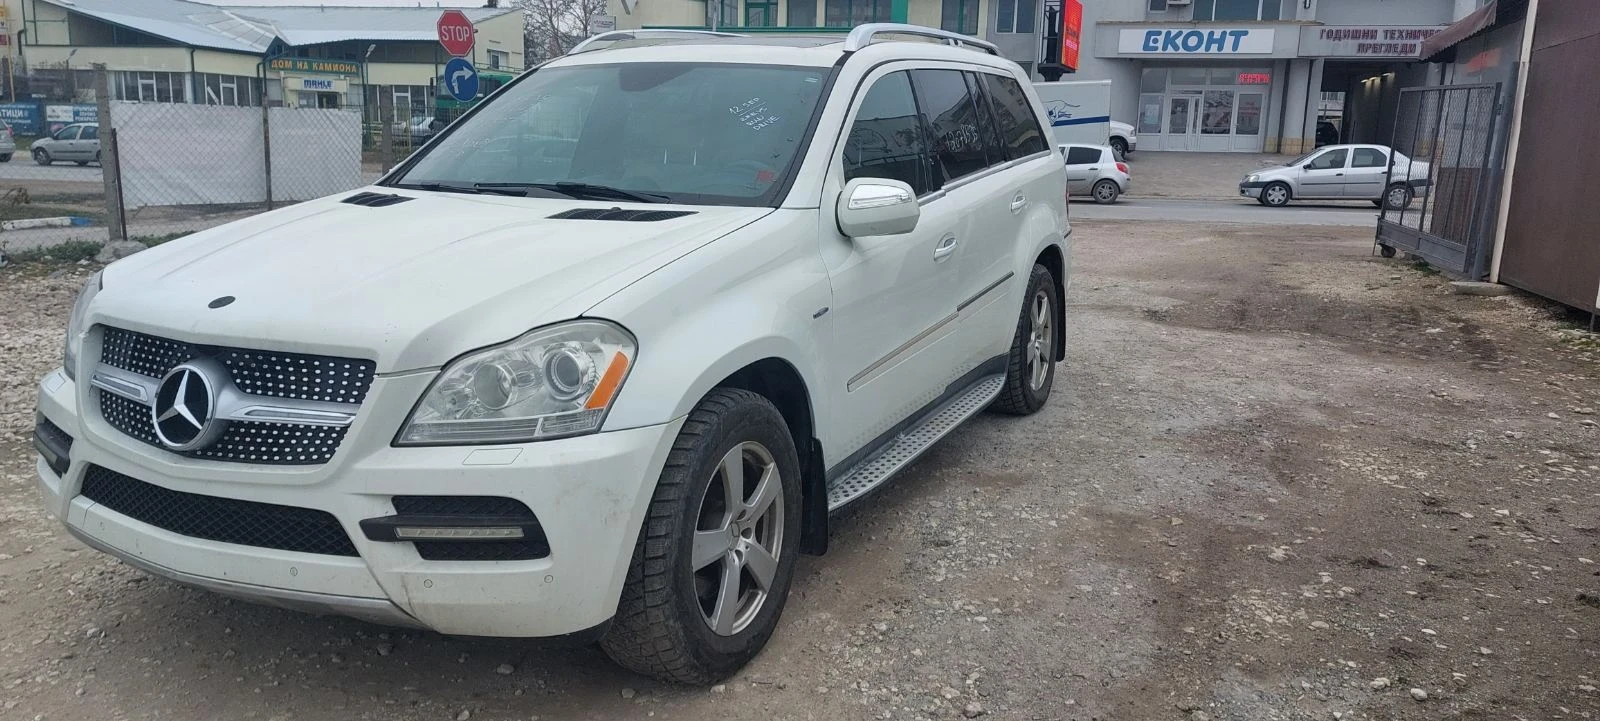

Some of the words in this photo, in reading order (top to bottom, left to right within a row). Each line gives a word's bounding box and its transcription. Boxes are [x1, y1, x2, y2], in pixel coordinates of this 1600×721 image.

[441, 25, 470, 42] STOP
[1320, 29, 1378, 42] ГОДИШНИ
[1142, 30, 1249, 53] ЕКОНТ
[1356, 42, 1417, 55] ПРЕГЛЕДИ
[271, 59, 293, 70] ДОМ
[297, 60, 308, 70] НА
[312, 61, 357, 73] КАМИОНА
[303, 79, 333, 90] MAHLE
